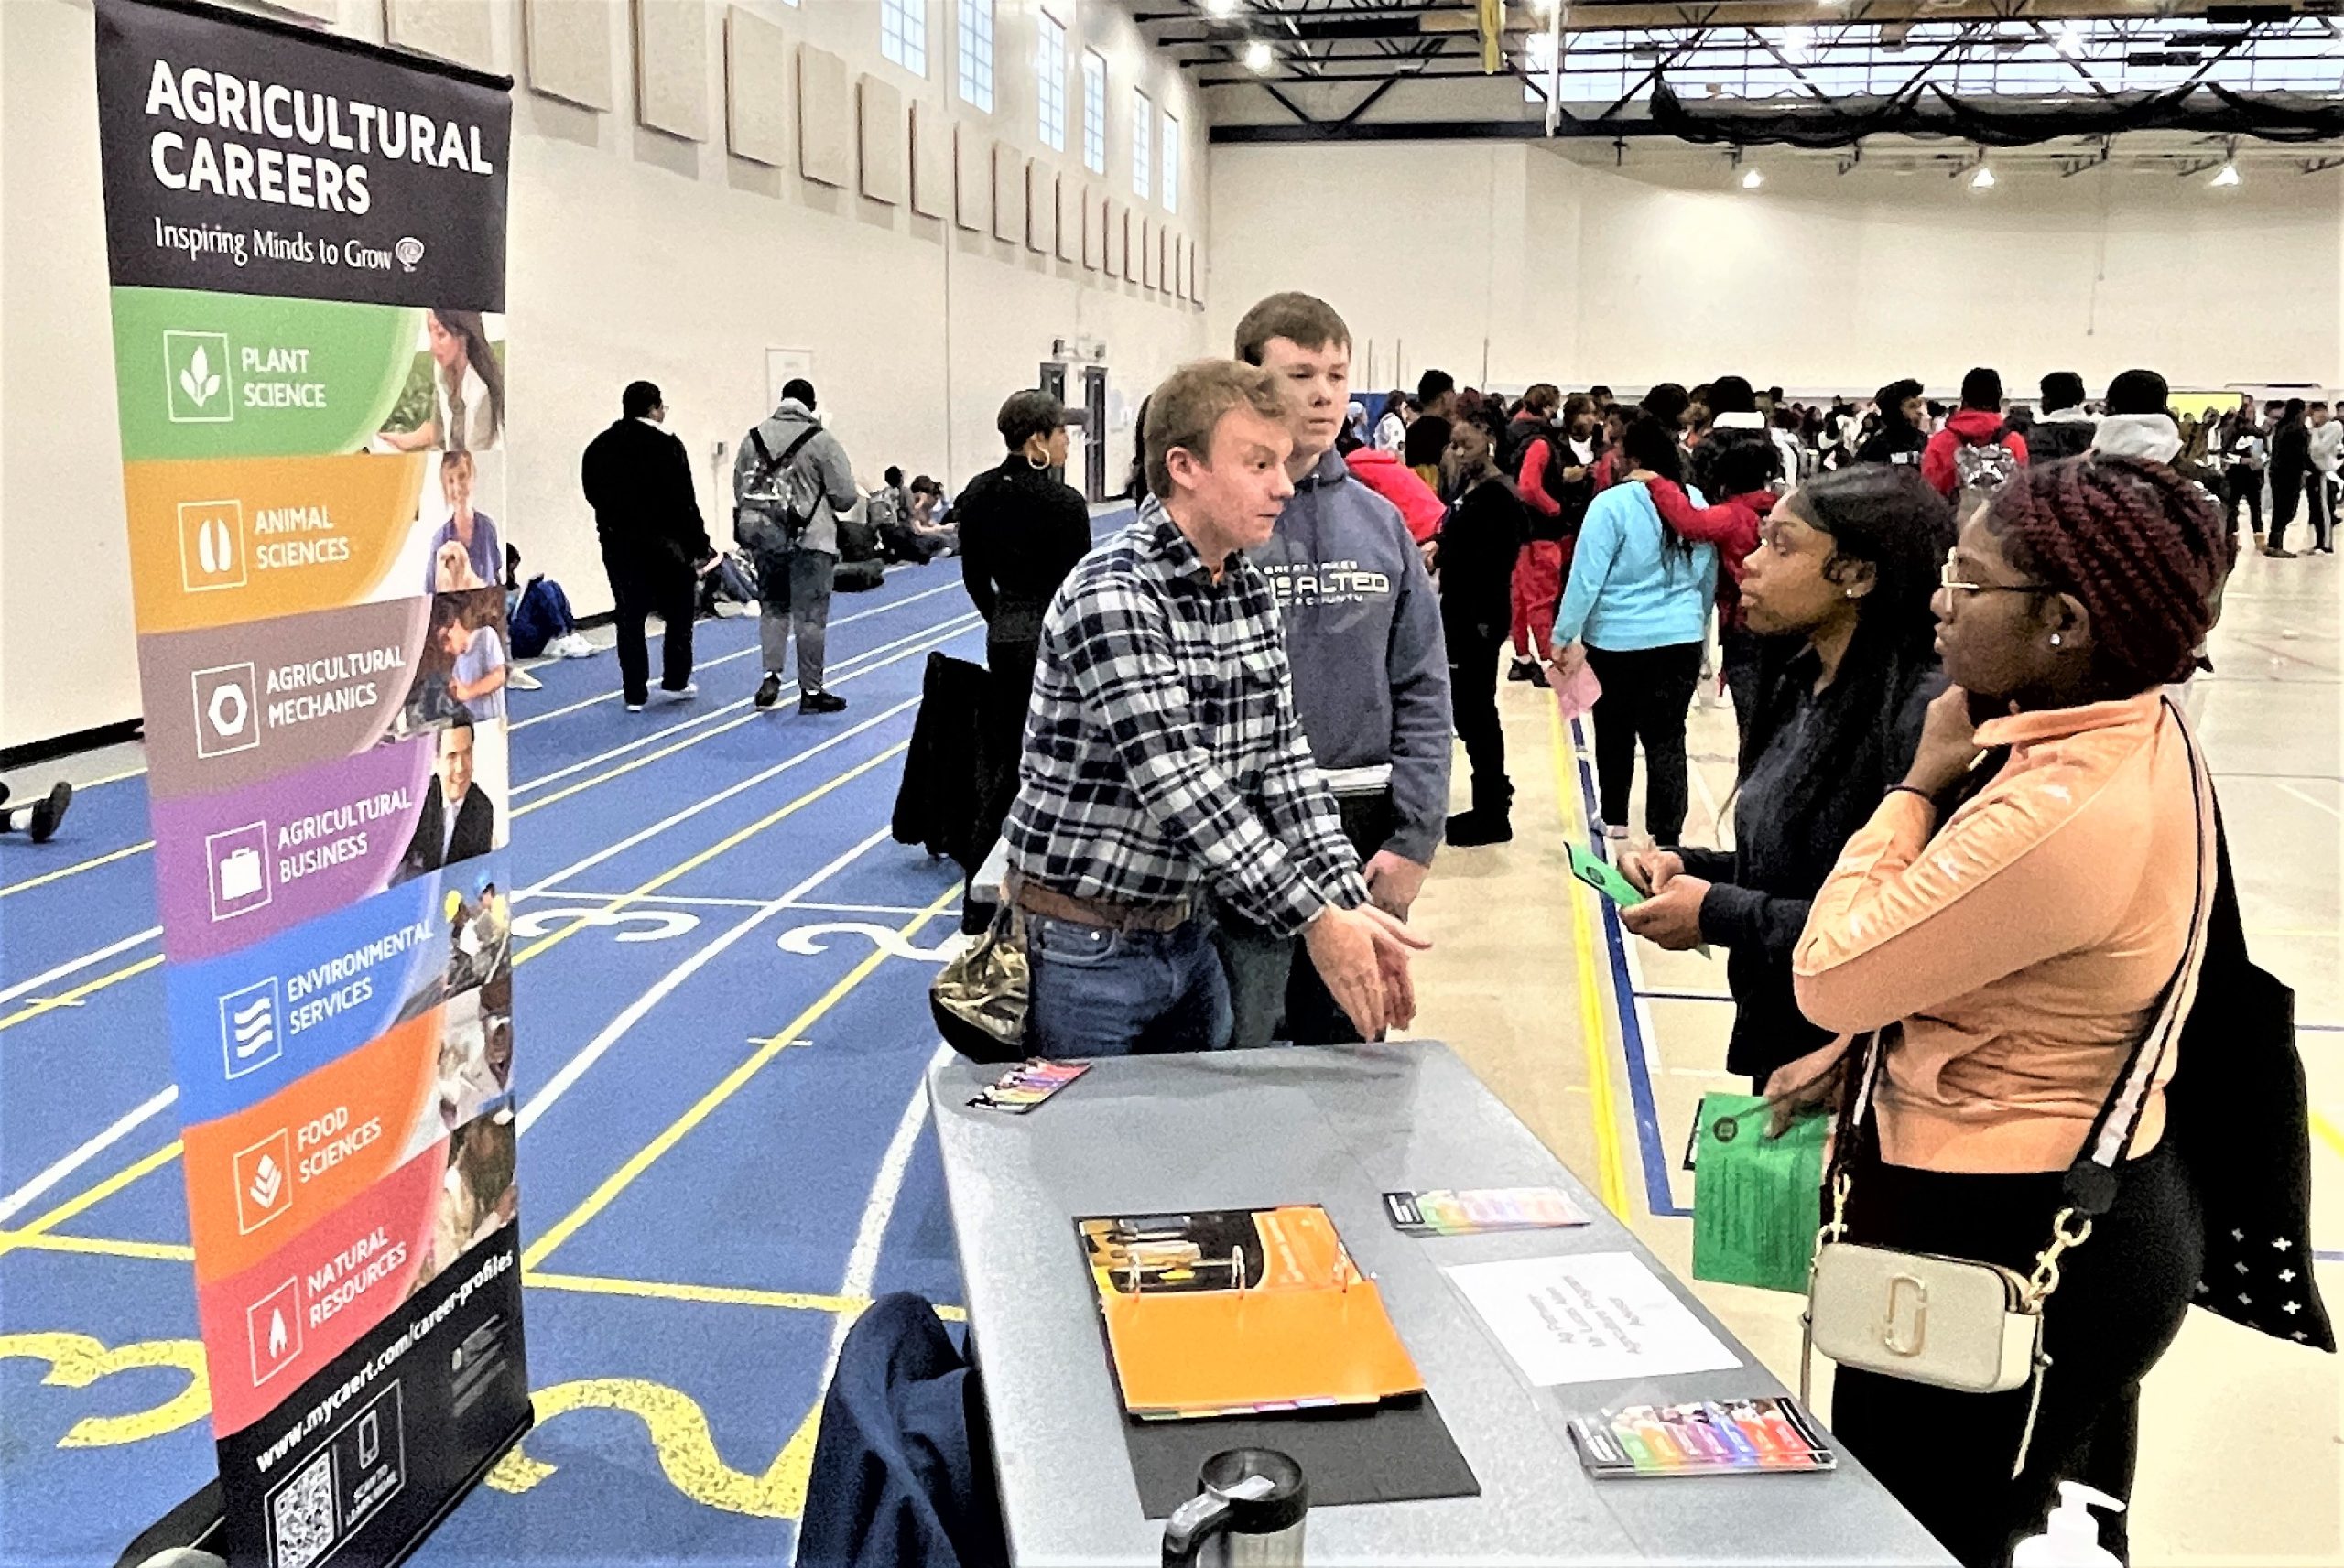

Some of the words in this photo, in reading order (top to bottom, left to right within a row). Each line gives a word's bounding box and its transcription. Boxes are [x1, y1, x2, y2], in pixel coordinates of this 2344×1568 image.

[145, 59, 494, 176] AGRICULTURAL
[150, 130, 372, 215] CAREERS
[154, 216, 248, 268] Inspiring
[253, 228, 315, 265] Minds
[320, 238, 340, 265] to
[344, 239, 393, 271] Grow
[241, 346, 310, 373] PLANT
[243, 382, 328, 408] SCIENCE
[254, 504, 335, 535] ANIMAL
[255, 536, 351, 570] SCIENCES
[266, 645, 407, 696] AGRICULTURAL
[267, 682, 379, 729] MECHANICS
[277, 786, 414, 852] AGRICULTURAL
[278, 831, 369, 884] BUSINESS
[286, 918, 435, 1002] ENVIRONMENTAL
[289, 976, 374, 1036] SERVICES
[296, 1105, 349, 1152] FOOD
[298, 1115, 382, 1184] SCIENCES
[307, 1225, 389, 1298] NATURAL
[309, 1240, 407, 1329] RESOURCES
[255, 1249, 515, 1473] www.mycaert.com/career-profiles
